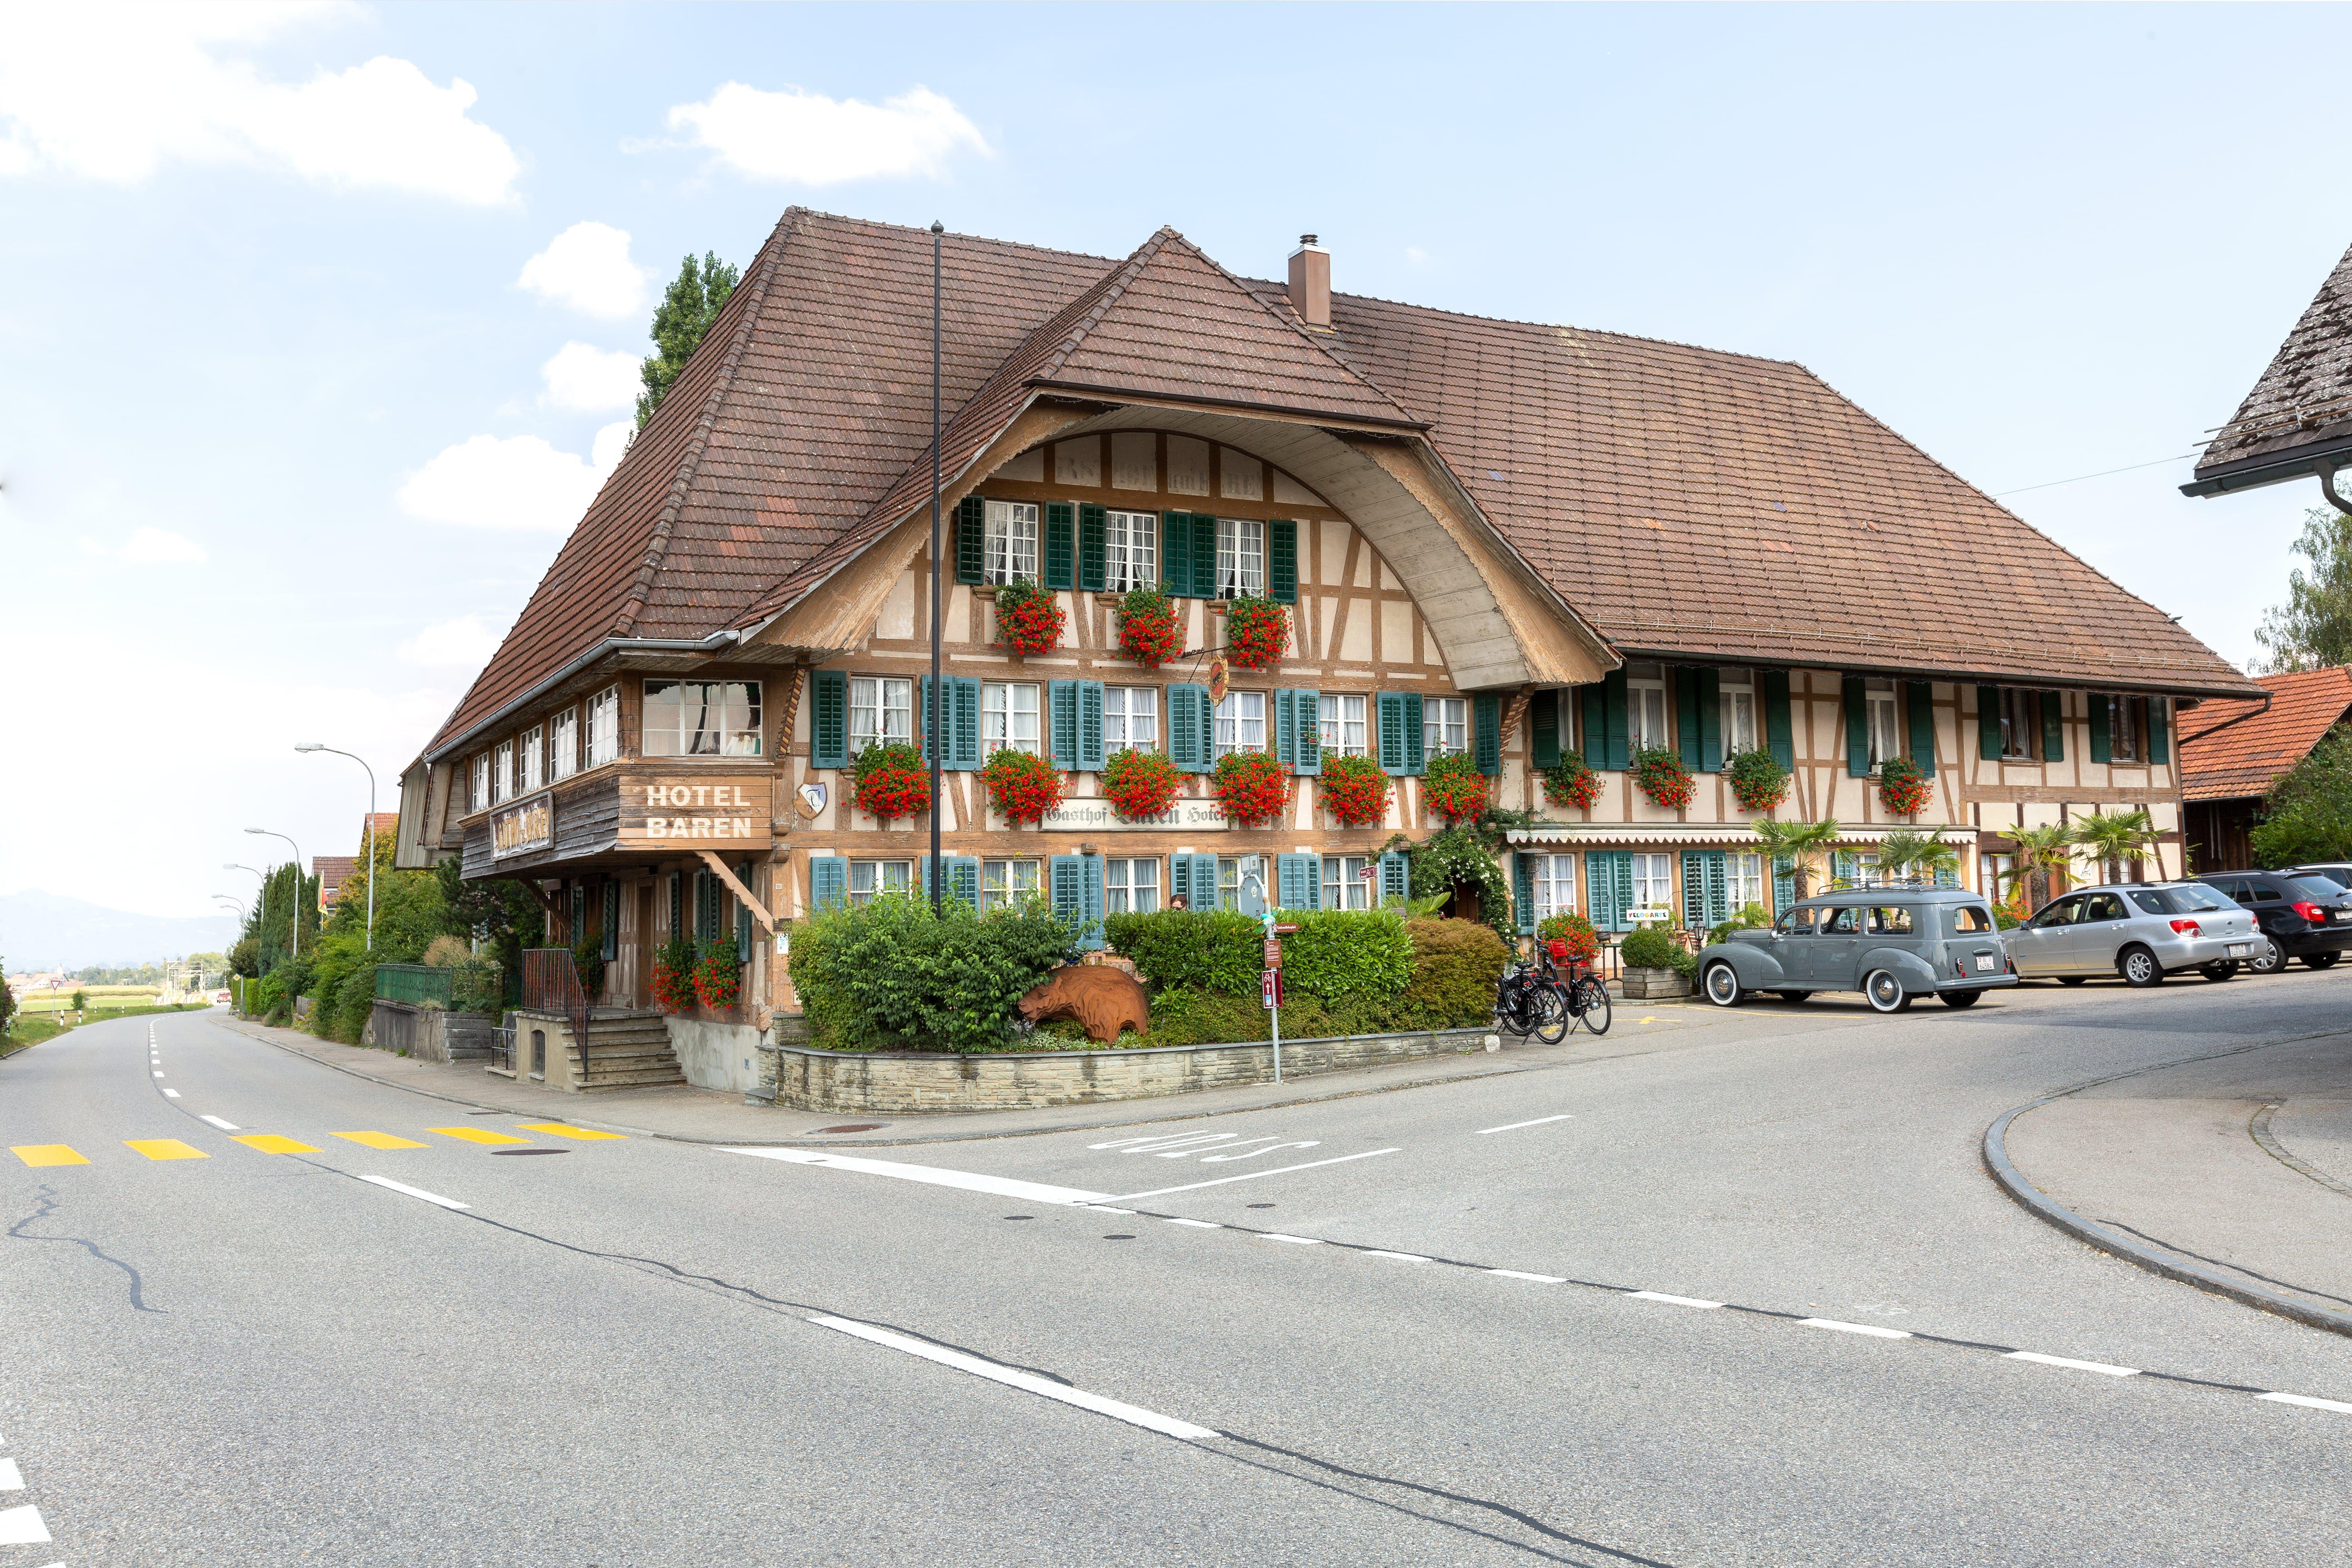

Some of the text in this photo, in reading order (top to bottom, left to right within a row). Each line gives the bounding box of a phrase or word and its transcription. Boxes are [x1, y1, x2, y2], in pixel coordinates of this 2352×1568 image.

[647, 785, 751, 806] HOTEL
[1046, 806, 1107, 826] Gasthof
[1187, 806, 1225, 826] Hotel
[647, 817, 751, 838] BÄREN
[1087, 1130, 1321, 1162] STOP
